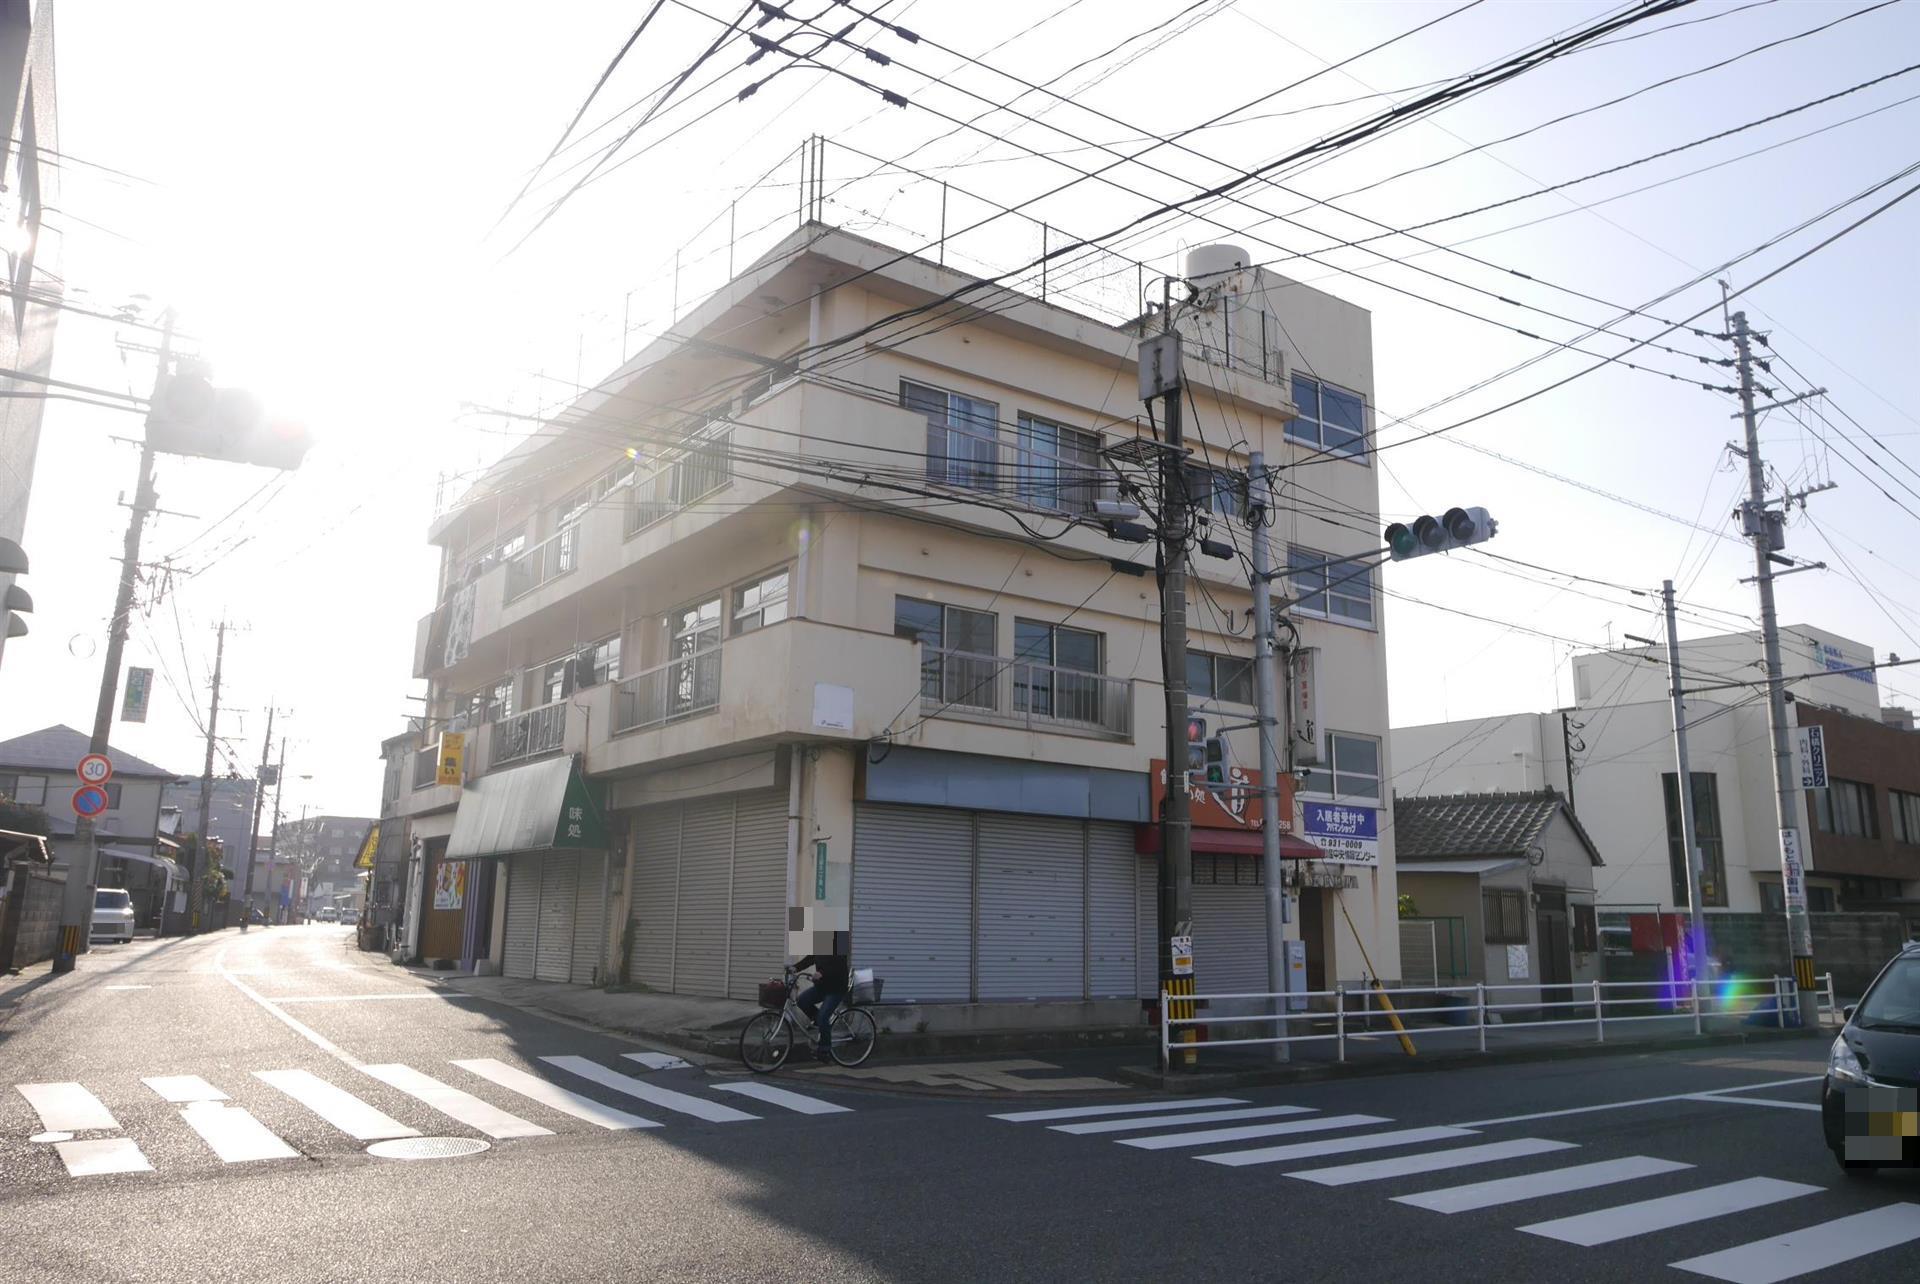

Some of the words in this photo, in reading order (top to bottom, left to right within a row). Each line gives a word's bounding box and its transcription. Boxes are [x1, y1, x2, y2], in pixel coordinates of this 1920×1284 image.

[85, 762, 105, 776] 30
[567, 807, 582, 837] 味処
[1316, 809, 1365, 825] 入居者受付中
